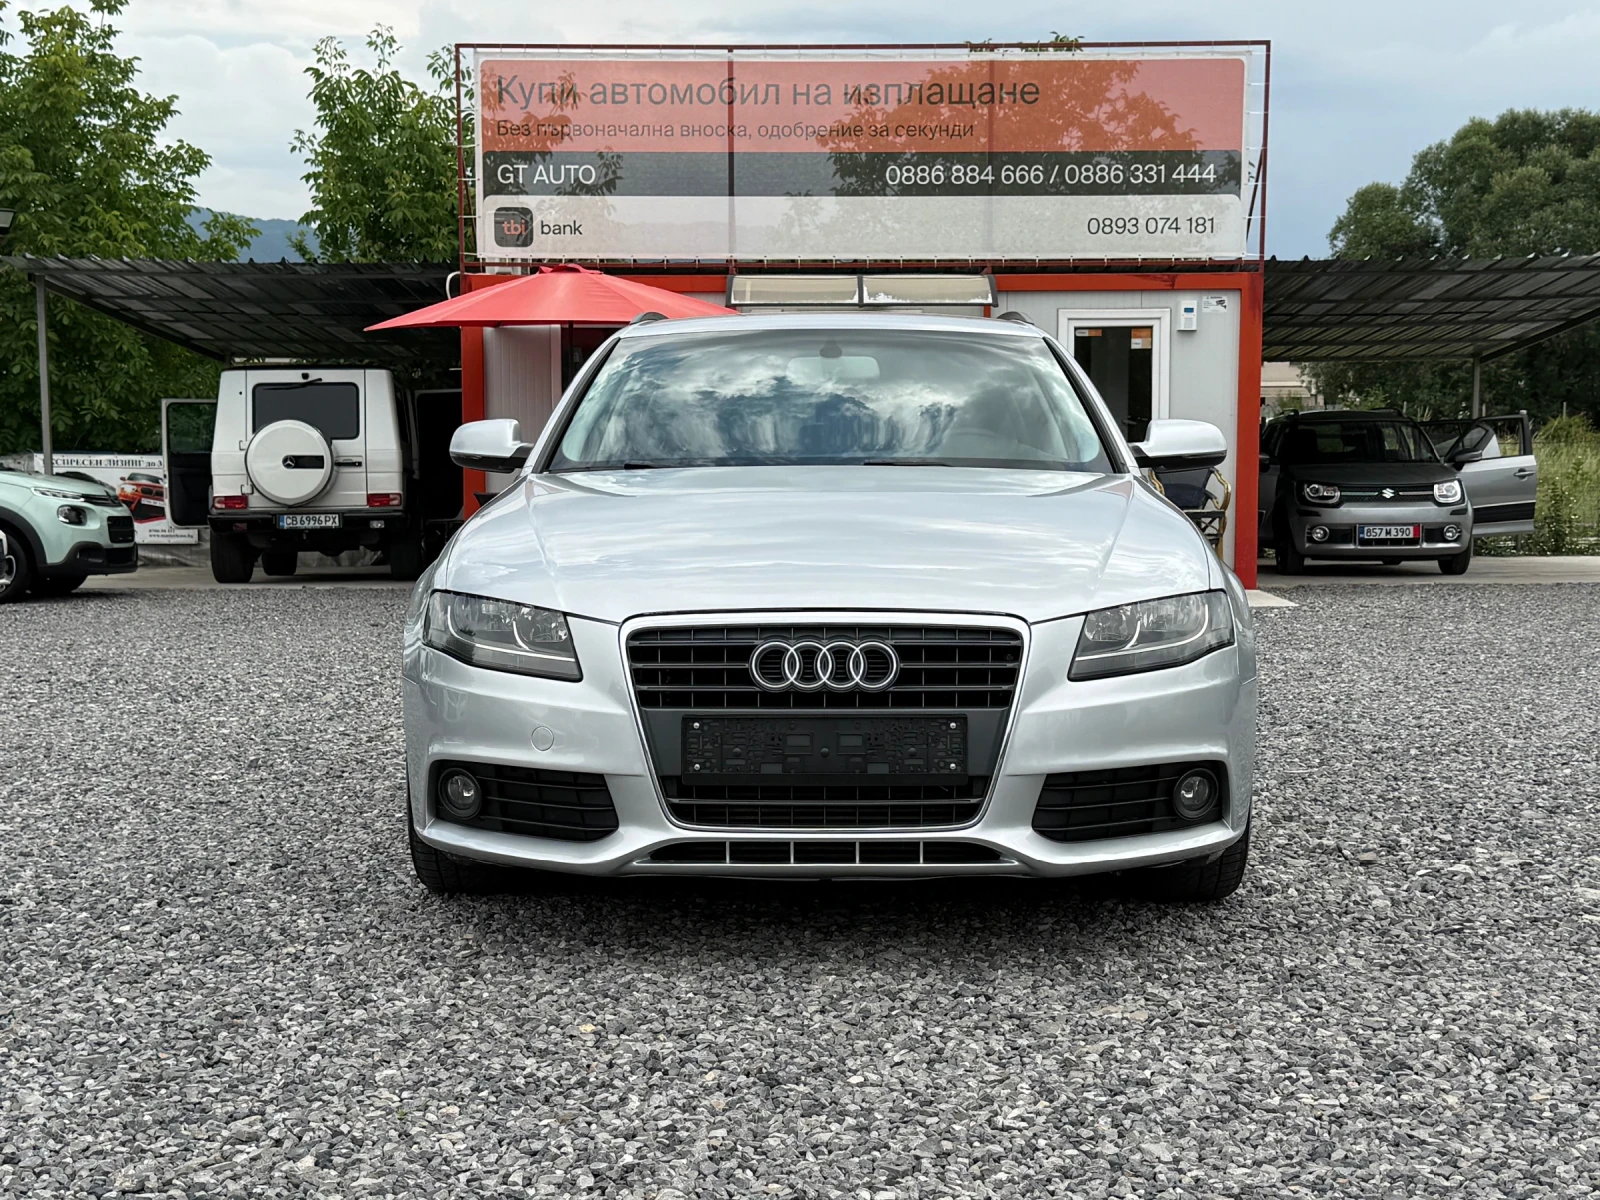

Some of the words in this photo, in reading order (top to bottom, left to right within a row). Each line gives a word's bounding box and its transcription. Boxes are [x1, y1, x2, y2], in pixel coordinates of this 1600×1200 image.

[497, 75, 578, 110] Купи
[590, 77, 780, 106] автомобил
[793, 83, 832, 106] на
[843, 81, 1040, 109] изплащане
[497, 120, 531, 136] Без
[537, 123, 674, 140] първоначална
[680, 124, 752, 140] вноска,
[758, 122, 863, 140] одобрение
[868, 124, 889, 137] за
[895, 124, 974, 140] секунди
[497, 164, 529, 184] GT
[533, 164, 596, 185] AUTO
[885, 165, 945, 185] 0886
[951, 165, 995, 185] 884
[1001, 165, 1044, 185] 666
[1049, 164, 1059, 184] /
[1064, 164, 1124, 184] 0886
[1129, 164, 1166, 184] 331
[1172, 163, 1217, 183] 444
[502, 219, 527, 235] tbi
[541, 220, 583, 235] bank
[1087, 217, 1140, 235] 0893
[1145, 217, 1181, 234] 074
[1186, 216, 1215, 234] 181
[43, 458, 102, 467] СПРЕСЕН
[299, 515, 323, 526] 6996
[1365, 527, 1384, 538] 857
[1393, 527, 1411, 537] 390
